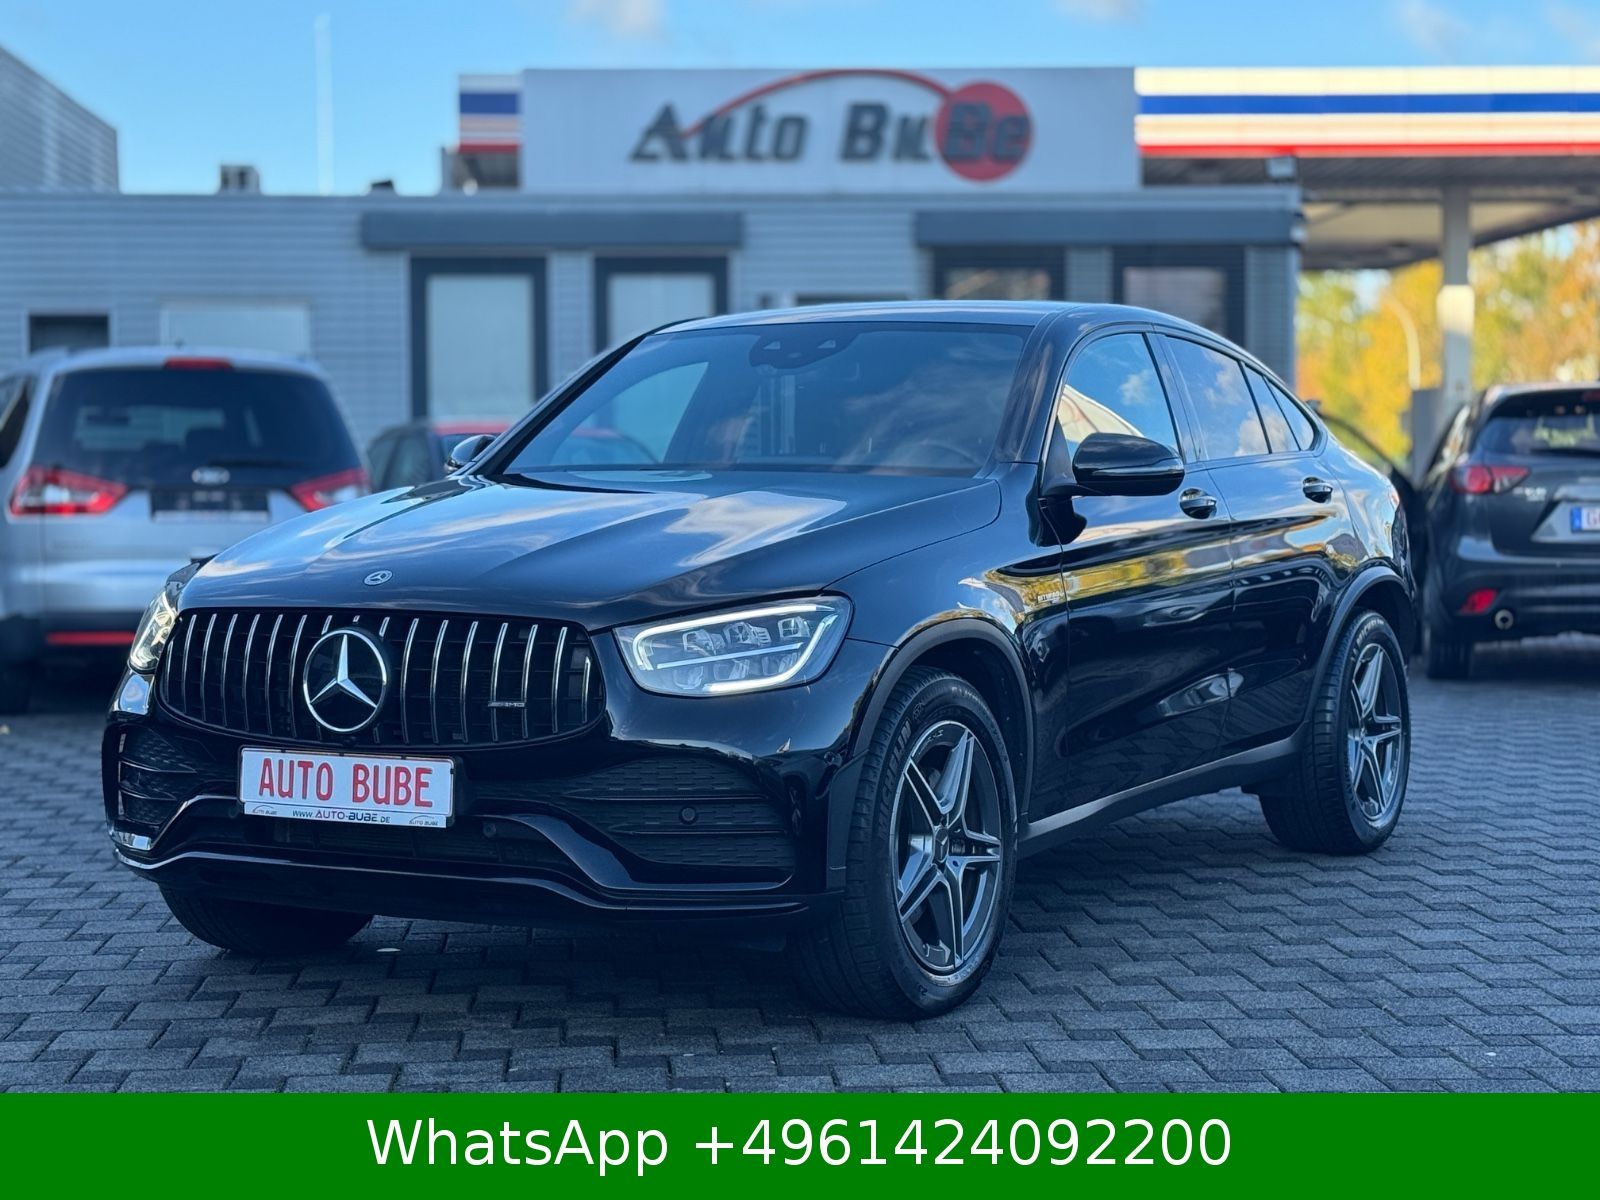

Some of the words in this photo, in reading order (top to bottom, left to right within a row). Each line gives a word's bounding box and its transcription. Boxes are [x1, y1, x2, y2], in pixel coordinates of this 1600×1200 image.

[629, 101, 809, 164] Auto
[259, 757, 334, 801] AUTO
[352, 763, 433, 808] BUBE
